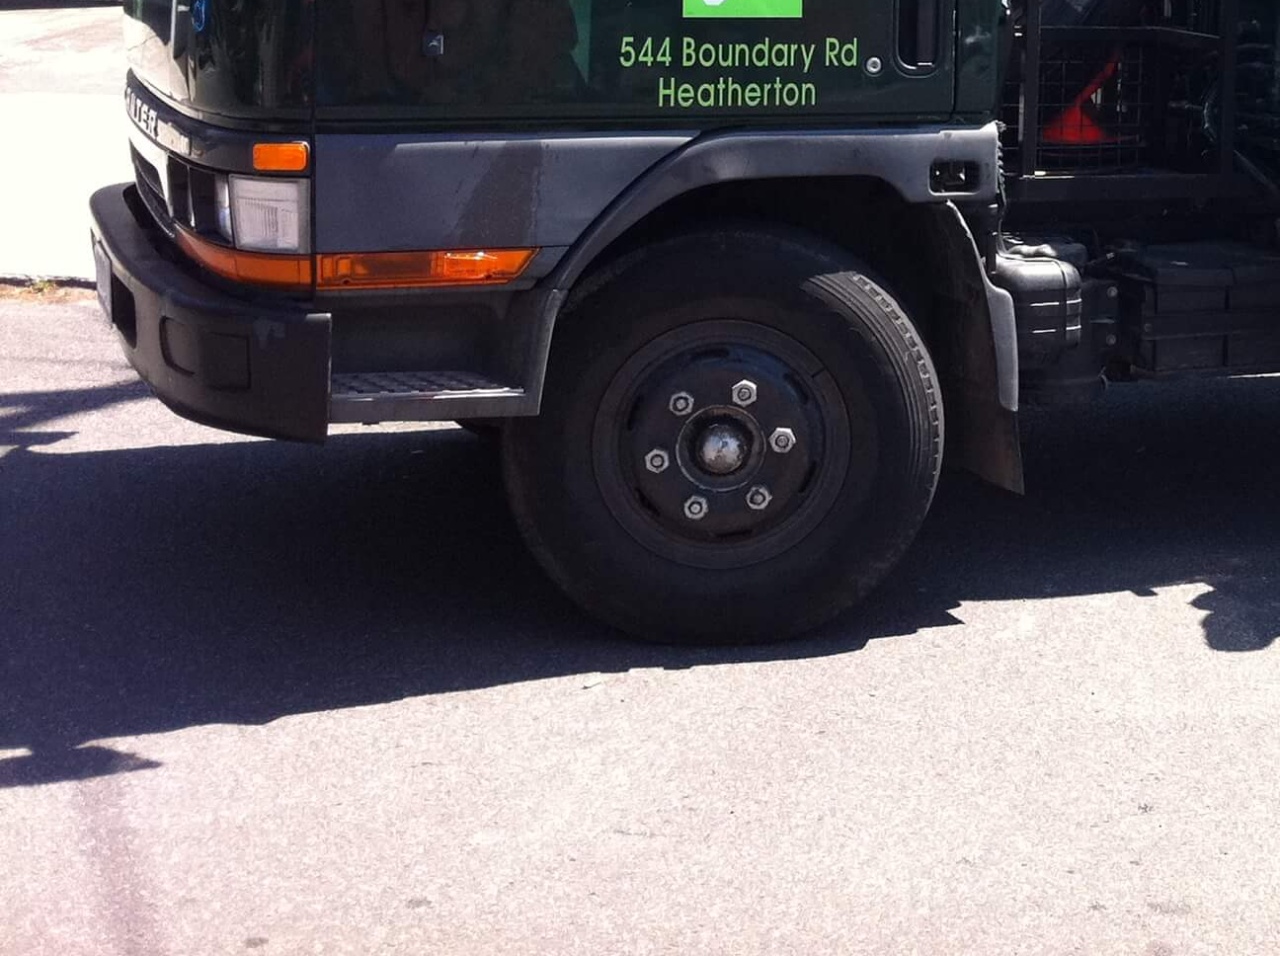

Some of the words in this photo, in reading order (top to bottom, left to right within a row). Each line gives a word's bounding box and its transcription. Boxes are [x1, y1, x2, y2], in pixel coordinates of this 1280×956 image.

[619, 36, 672, 69] 544
[682, 36, 817, 74] Boundary
[824, 37, 858, 68] Rd
[657, 77, 817, 108] Heatherton
